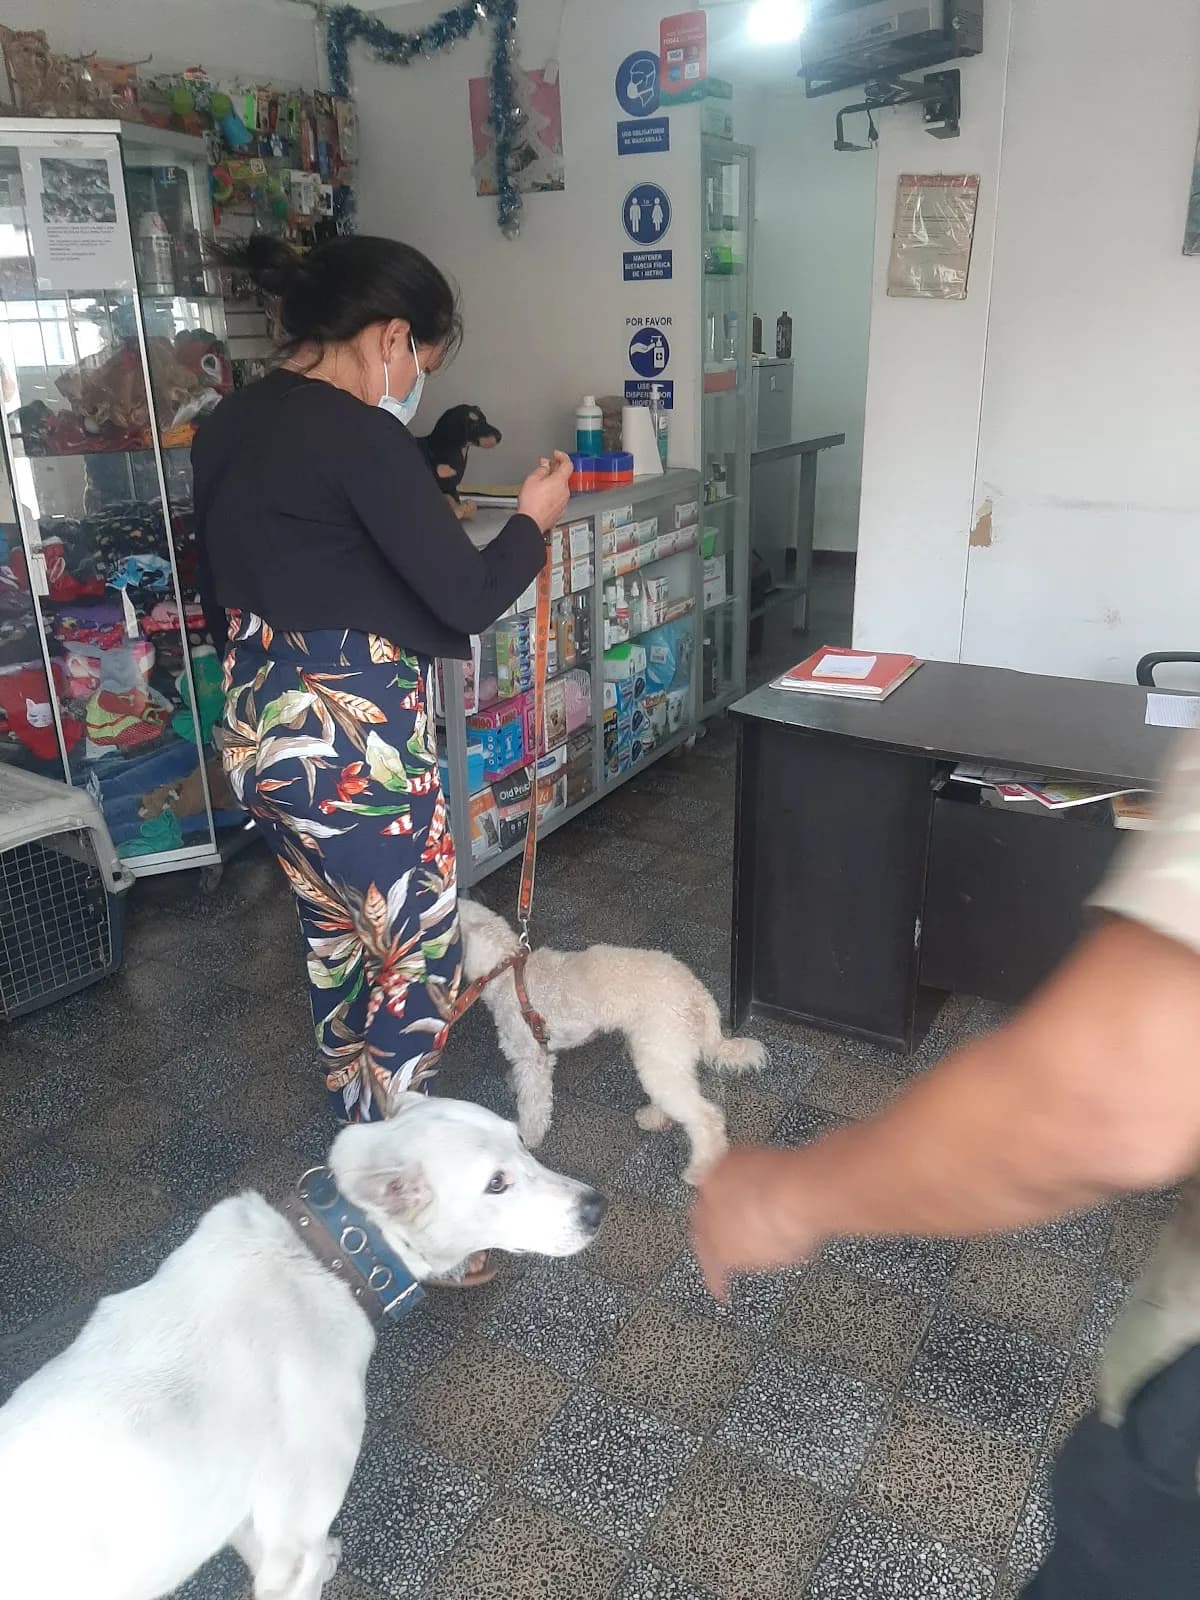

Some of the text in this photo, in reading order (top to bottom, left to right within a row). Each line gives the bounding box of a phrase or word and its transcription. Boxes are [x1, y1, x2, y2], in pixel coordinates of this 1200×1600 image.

[632, 127, 665, 136] OBLIGATORIO
[631, 135, 662, 144] MASCARILLA
[633, 254, 662, 262] MANTENER
[625, 262, 652, 270] DISTANCIA
[644, 269, 664, 277] METRO
[625, 316, 672, 326] POR FAVOR
[500, 787, 514, 800] Old
